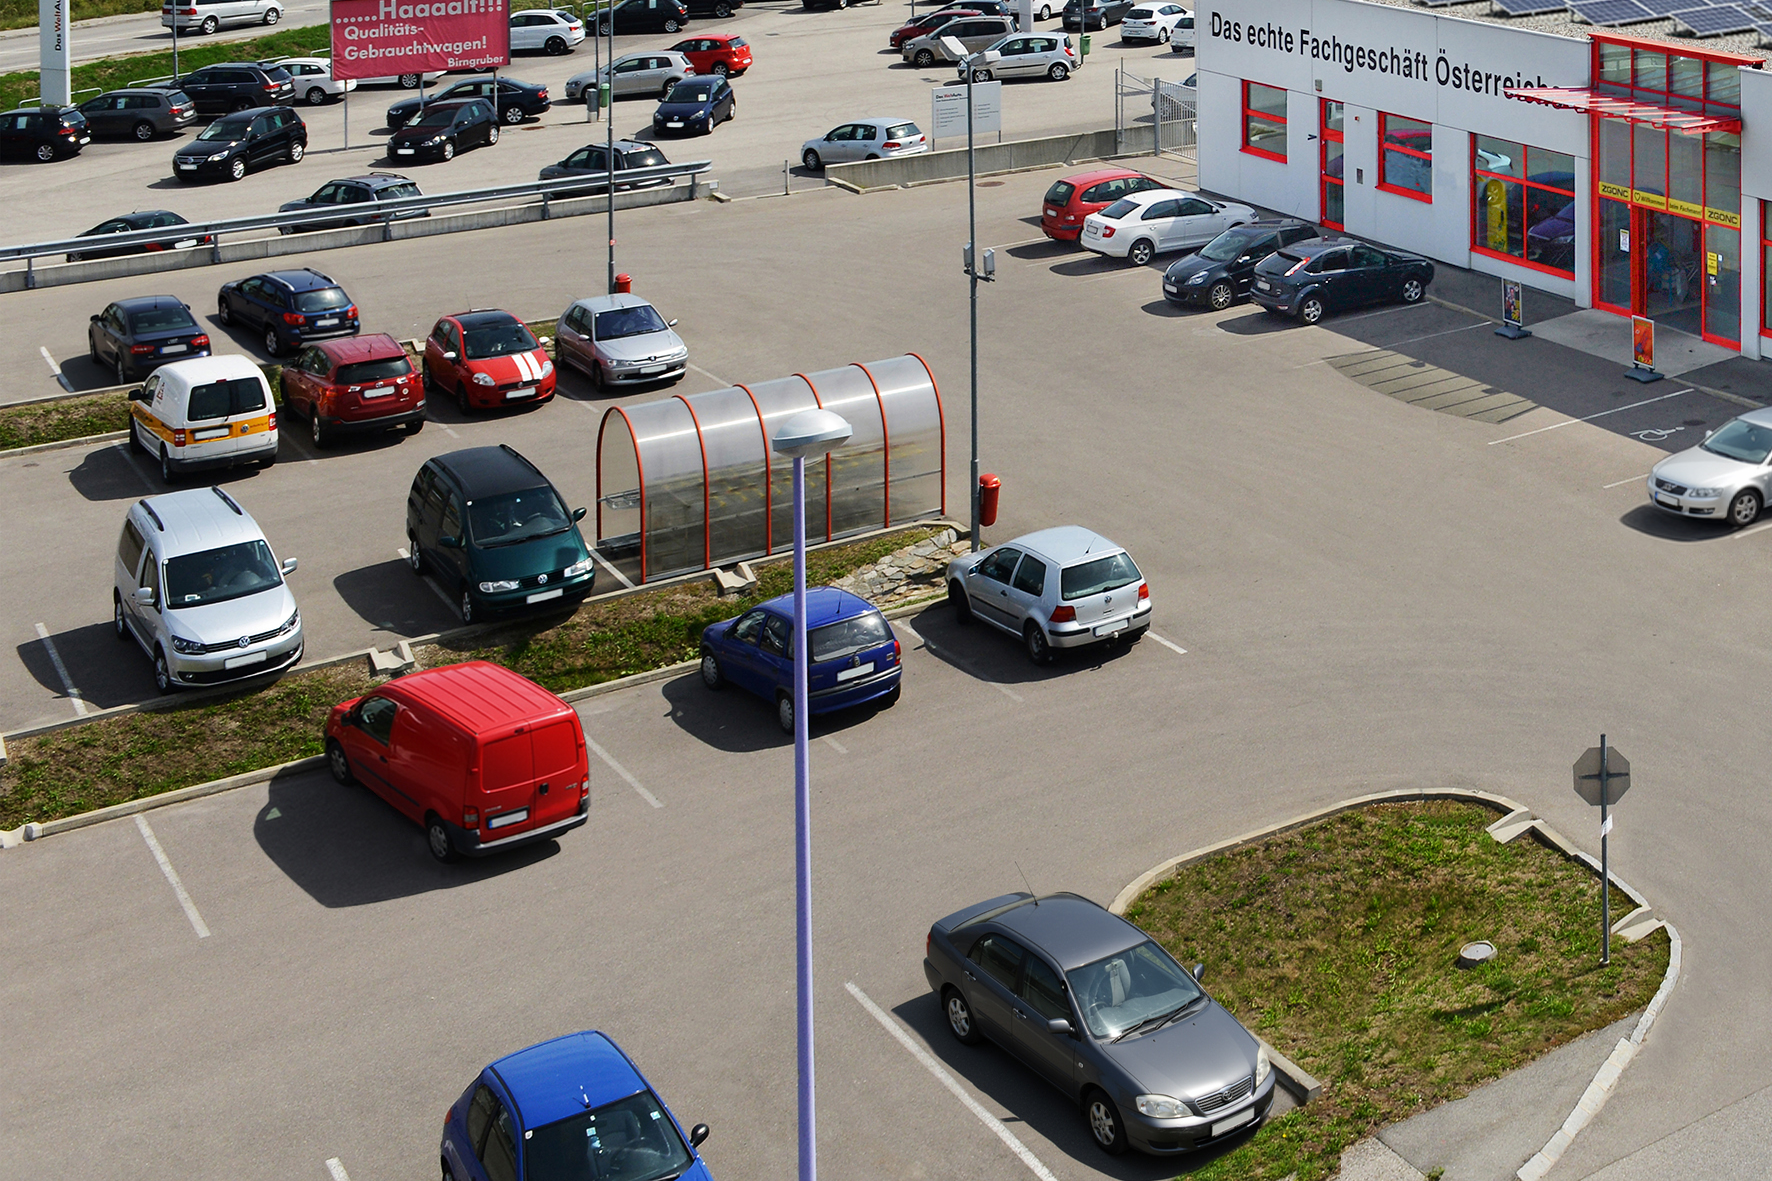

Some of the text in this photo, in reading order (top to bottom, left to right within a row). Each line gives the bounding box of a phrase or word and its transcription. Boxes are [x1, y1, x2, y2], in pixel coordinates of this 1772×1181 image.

[344, 23, 425, 40] Qualitäts-
[344, 36, 487, 61] Gebrauchtwagen!
[1211, 11, 1242, 42] Das
[1247, 22, 1294, 53] echte
[1300, 29, 1428, 82] Fachgeschäft
[447, 55, 504, 68] Birngruber
[1601, 184, 1629, 198] ZGONC
[1707, 210, 1738, 225] ZGONC
